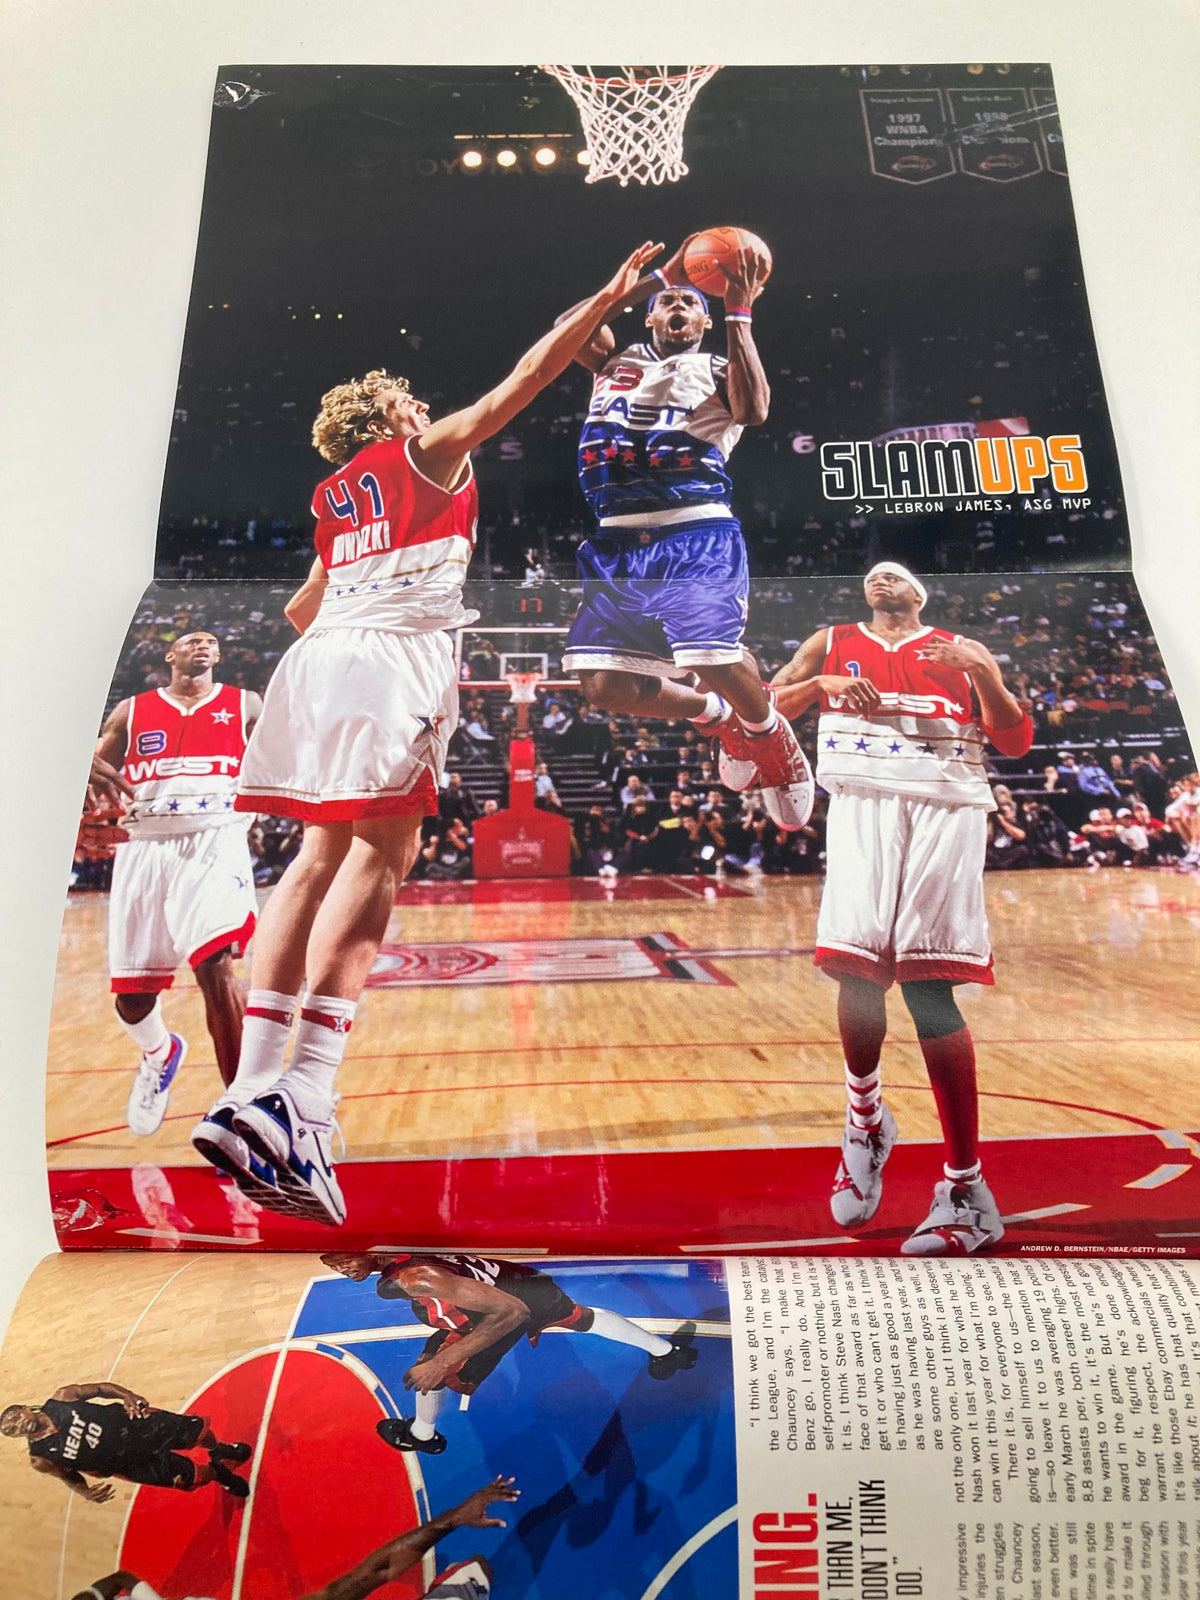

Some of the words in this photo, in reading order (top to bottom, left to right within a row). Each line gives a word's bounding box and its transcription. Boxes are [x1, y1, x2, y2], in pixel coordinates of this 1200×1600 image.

[886, 125, 928, 135] WNBA
[888, 113, 921, 123] 1997
[324, 471, 385, 527] 41
[885, 501, 944, 515] LEBRON
[955, 499, 1012, 513] JAMES,
[1023, 498, 1053, 511] ASG
[1063, 497, 1092, 510] MVP
[137, 729, 167, 756] 8
[128, 755, 240, 781] WEST
[778, 1290, 789, 1316] make
[794, 1290, 805, 1307] And
[970, 1302, 980, 1317] I'm
[1034, 1290, 1046, 1302] 19
[1069, 1292, 1085, 1316] most
[1106, 1294, 1121, 1320] done
[745, 1306, 754, 1322] the
[762, 1312, 772, 1328] I'm
[814, 1300, 826, 1344] nothing,
[830, 1300, 842, 1326] Nash
[866, 1311, 880, 1328] get
[902, 1312, 913, 1332] last
[952, 1306, 965, 1332] what
[1018, 1290, 1036, 1332] mention
[1092, 1303, 1105, 1326] he's
[1158, 1294, 1177, 1328] quality
[1182, 1313, 1196, 1334] that
[746, 1330, 759, 1348] got
[884, 1313, 899, 1340] good
[921, 1315, 934, 1340] guys
[938, 1324, 951, 1353] think
[974, 1323, 986, 1350] what
[1040, 1308, 1060, 1364] averaging
[1061, 1319, 1076, 1356] career
[1140, 1292, 1168, 1364] commercials
[764, 1338, 775, 1359] and
[800, 1339, 811, 1371] really
[836, 1333, 846, 1366] Steve
[851, 1332, 864, 1367] award
[869, 1333, 881, 1363] can't
[906, 1337, 918, 1376] having
[959, 1337, 968, 1352] for
[992, 1322, 1008, 1377] everyone
[1100, 1335, 1112, 1354] But
[1117, 1330, 1130, 1356] he's
[1136, 1334, 1147, 1352] the
[784, 1346, 795, 1376] says.
[926, 1347, 936, 1379] other
[1085, 1348, 1096, 1367] it's
[874, 1368, 884, 1393] who
[891, 1364, 904, 1388] just
[944, 1366, 955, 1386] but
[962, 1358, 976, 1385] year
[1014, 1361, 1030, 1408] himself
[1069, 1362, 1082, 1390] both
[1108, 1365, 1123, 1404] game.
[1162, 1370, 1175, 1400] Ebay
[1179, 1364, 1191, 1387] has
[749, 1379, 760, 1410] think
[768, 1370, 779, 1419] League,
[838, 1373, 849, 1404] think
[856, 1373, 866, 1398] that
[912, 1382, 921, 1408] was
[983, 1376, 996, 1404] year
[1001, 1383, 1011, 1400] for
[1124, 1367, 1142, 1414] figuring
[1142, 1362, 1159, 1414] respect,
[820, 1364, 834, 1450] self-promoter
[894, 1392, 905, 1434] having
[930, 1386, 941, 1422] some
[949, 1392, 959, 1420] one,
[966, 1392, 976, 1415] last
[1076, 1397, 1089, 1420] per,
[787, 1388, 797, 1450] Chauncey
[986, 1410, 997, 1434] this
[1022, 1418, 1034, 1440] sell
[1114, 1413, 1125, 1434] the
[1169, 1408, 1181, 1444] those
[62, 1410, 86, 1460] HEAT
[85, 1422, 103, 1449] 40
[805, 1419, 816, 1450] Benz
[860, 1423, 870, 1450] face
[878, 1430, 891, 1450] get
[934, 1430, 943, 1450] are
[950, 1425, 962, 1451] only
[1042, 1418, 1053, 1452] leave
[1060, 1425, 1072, 1465] March
[971, 1437, 980, 1463] won
[990, 1453, 1000, 1474] win
[1008, 1444, 1018, 1480] There
[1079, 1427, 1092, 1474] assists
[1099, 1441, 1110, 1480] wants
[1173, 1452, 1184, 1474] like
[1189, 1435, 1200, 1471] about
[953, 1456, 964, 1477] the
[1154, 1454, 1167, 1501] warrant
[954, 1482, 964, 1502] not
[972, 1469, 983, 1502] Nash
[992, 1480, 1002, 1503] can
[1028, 1468, 1041, 1503] going
[1064, 1472, 1076, 1502] early
[1082, 1480, 1094, 1502] 8.8
[1118, 1464, 1130, 1501] award
[1138, 1478, 1150, 1502] beg
[825, 1497, 854, 1531] ME,
[858, 1480, 887, 1537] THINK
[826, 1541, 854, 1590] THAN
